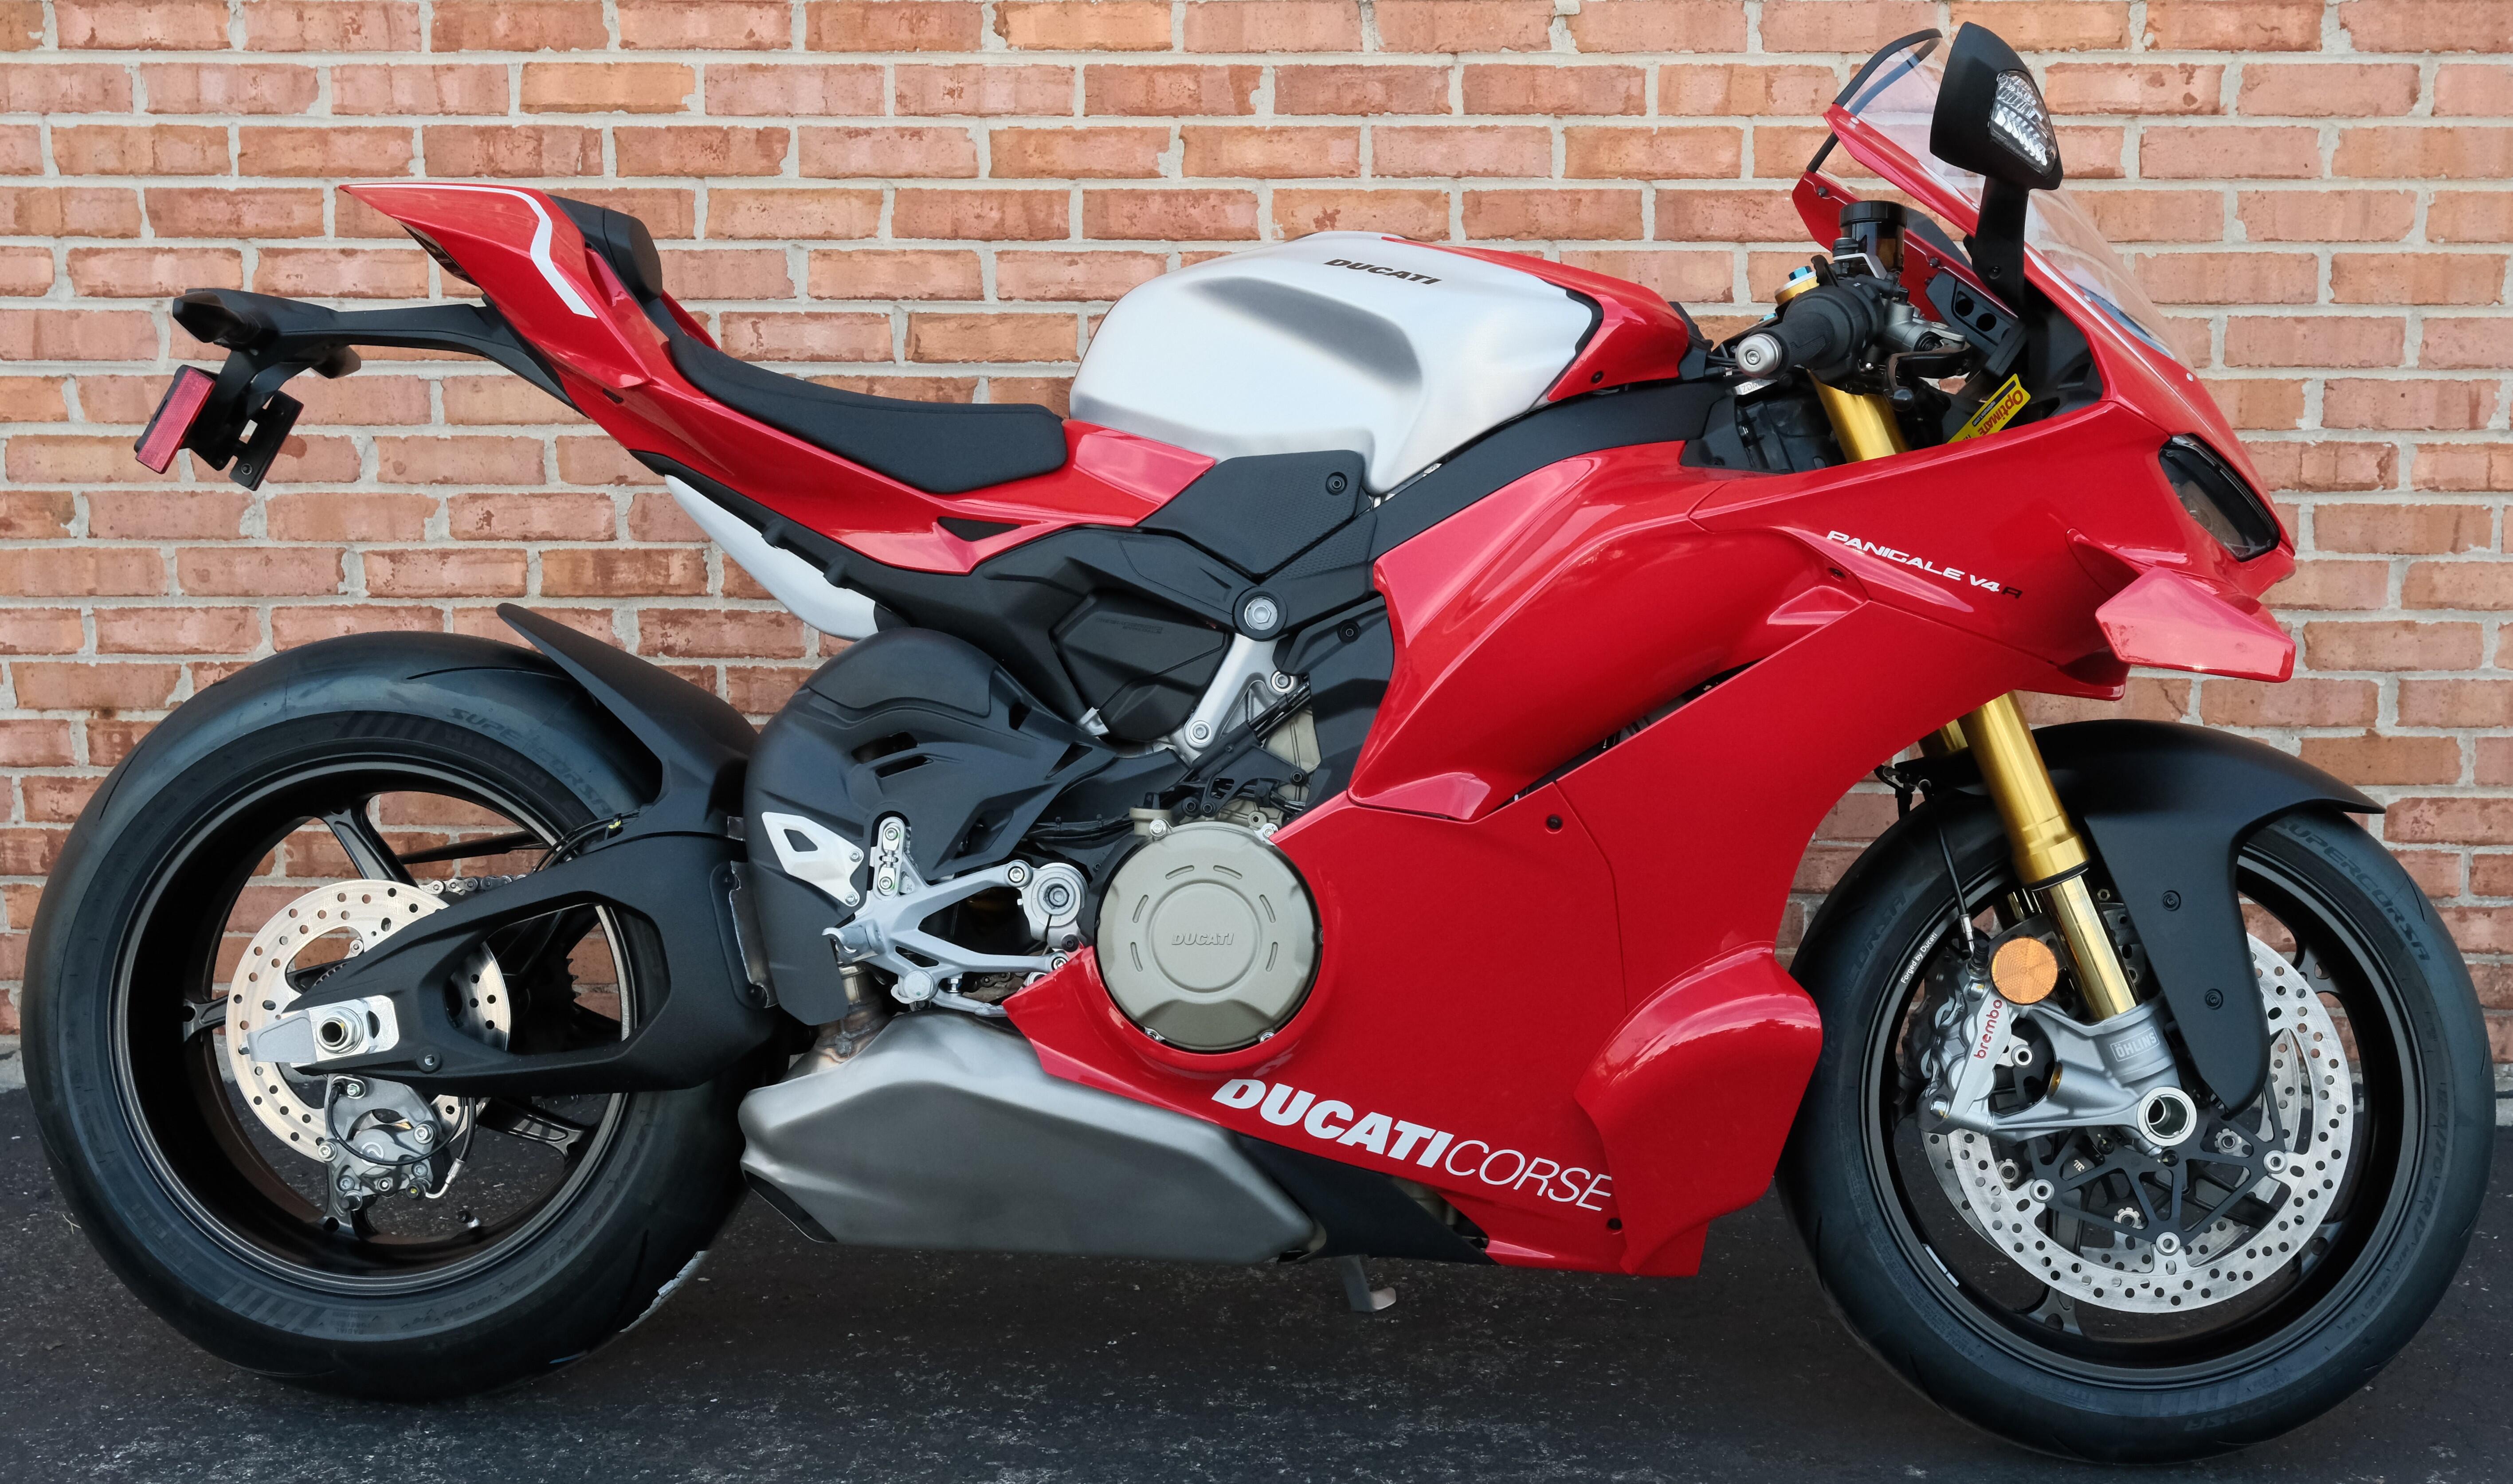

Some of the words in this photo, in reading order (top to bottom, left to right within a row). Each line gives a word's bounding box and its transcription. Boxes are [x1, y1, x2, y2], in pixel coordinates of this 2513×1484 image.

[1323, 258, 1443, 285] DUCATI
[1826, 530, 1965, 580] PANIGALE
[1969, 574, 2000, 592] V4
[447, 708, 613, 815] SUPECORSA
[1171, 933, 1234, 945] DUCATI
[1901, 959, 1917, 984] Forged
[1913, 952, 1924, 963] by
[1921, 932, 1938, 955] Ducati
[1973, 999, 2003, 1060] brembo
[2115, 1034, 2158, 1055] ÖHLINS
[1211, 1079, 1454, 1168] DUCATI
[1444, 1139, 1612, 1211] CORSE
